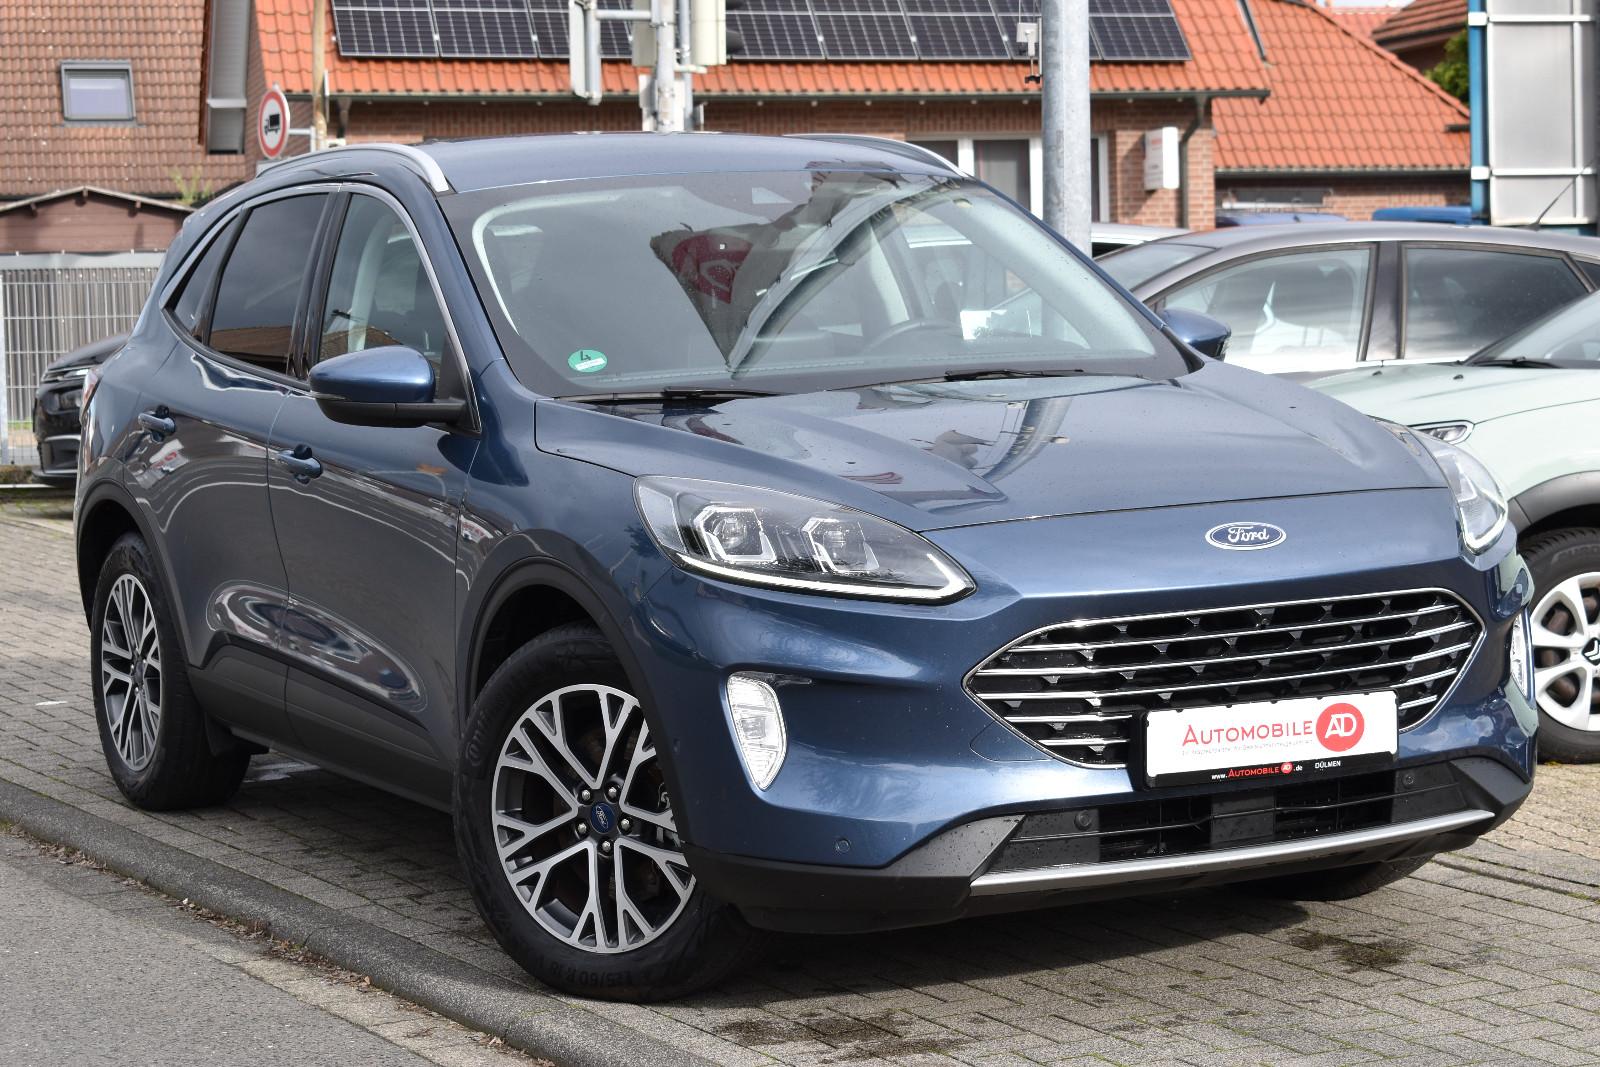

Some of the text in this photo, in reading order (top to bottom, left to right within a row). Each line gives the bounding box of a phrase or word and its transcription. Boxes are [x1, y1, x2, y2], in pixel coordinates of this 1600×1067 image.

[1227, 525, 1270, 543] Ford
[1182, 720, 1313, 747] AUTOMOBILE
[1314, 760, 1342, 771] DÜLMEN
